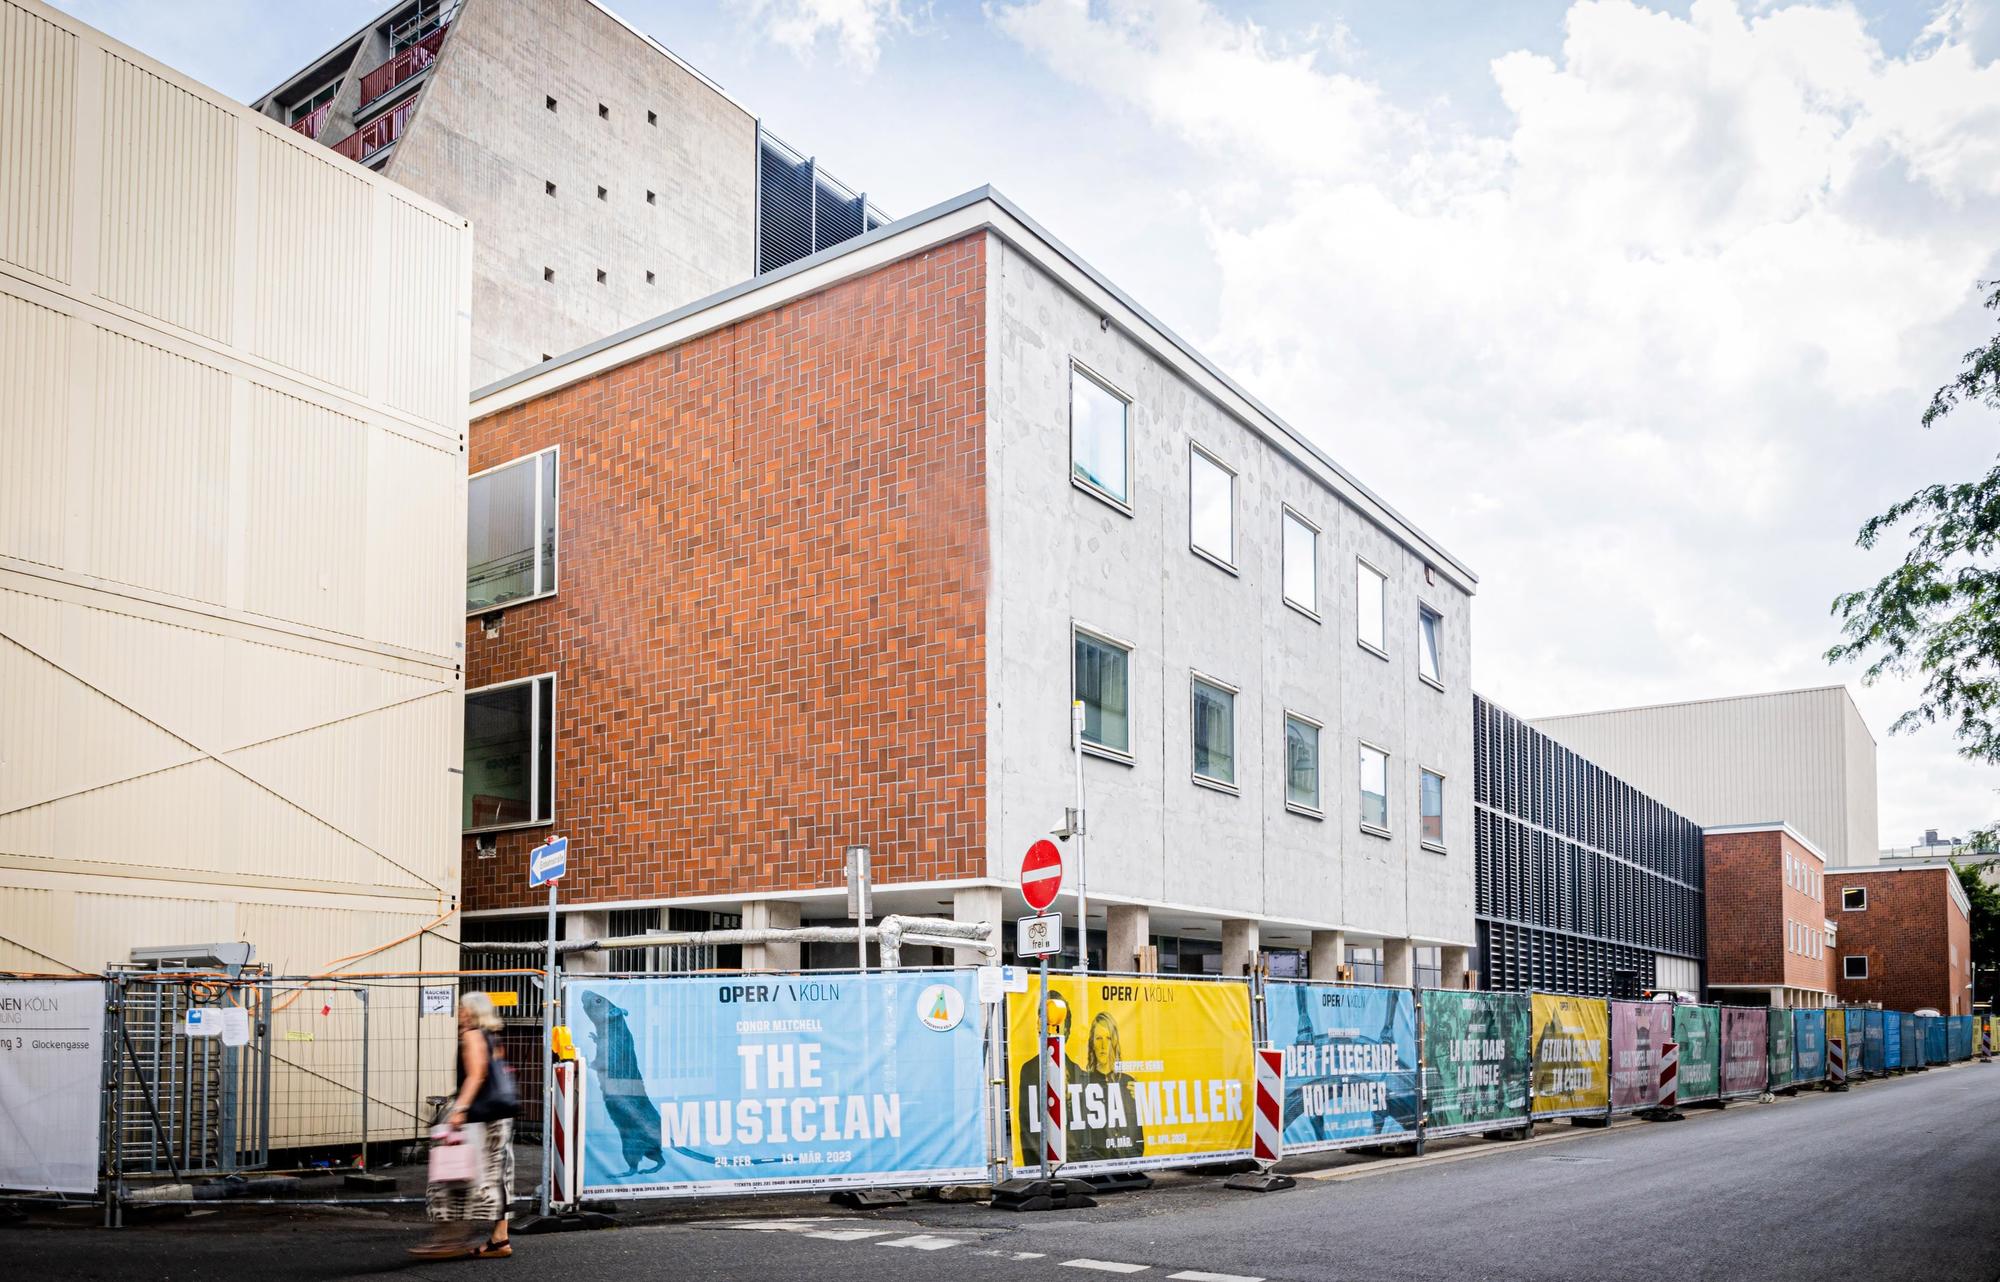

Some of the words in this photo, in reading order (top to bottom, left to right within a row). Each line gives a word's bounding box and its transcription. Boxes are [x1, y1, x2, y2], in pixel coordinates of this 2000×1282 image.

[1032, 938, 1044, 949] frei
[24, 996, 58, 1011] KÖLN
[736, 1020, 769, 1032] CONOR
[772, 1019, 822, 1032] MITCHELL
[16, 1037, 23, 1048] 3
[32, 1040, 89, 1051] Glockengasse
[1482, 1039, 1506, 1061] DANS
[737, 1043, 822, 1090] THE
[1286, 1044, 1316, 1077] DER
[1321, 1043, 1399, 1076] FLIEGENDE
[1028, 1082, 1128, 1133] LISA
[1134, 1079, 1244, 1127] MILLER
[1302, 1077, 1388, 1117] HOLLÄNDER
[660, 1093, 900, 1149] MUSICIAN
[715, 1156, 731, 1168] 24.
[732, 1155, 754, 1167] FEB.
[799, 1151, 825, 1164] MÄR.
[826, 1150, 852, 1163] 2023
